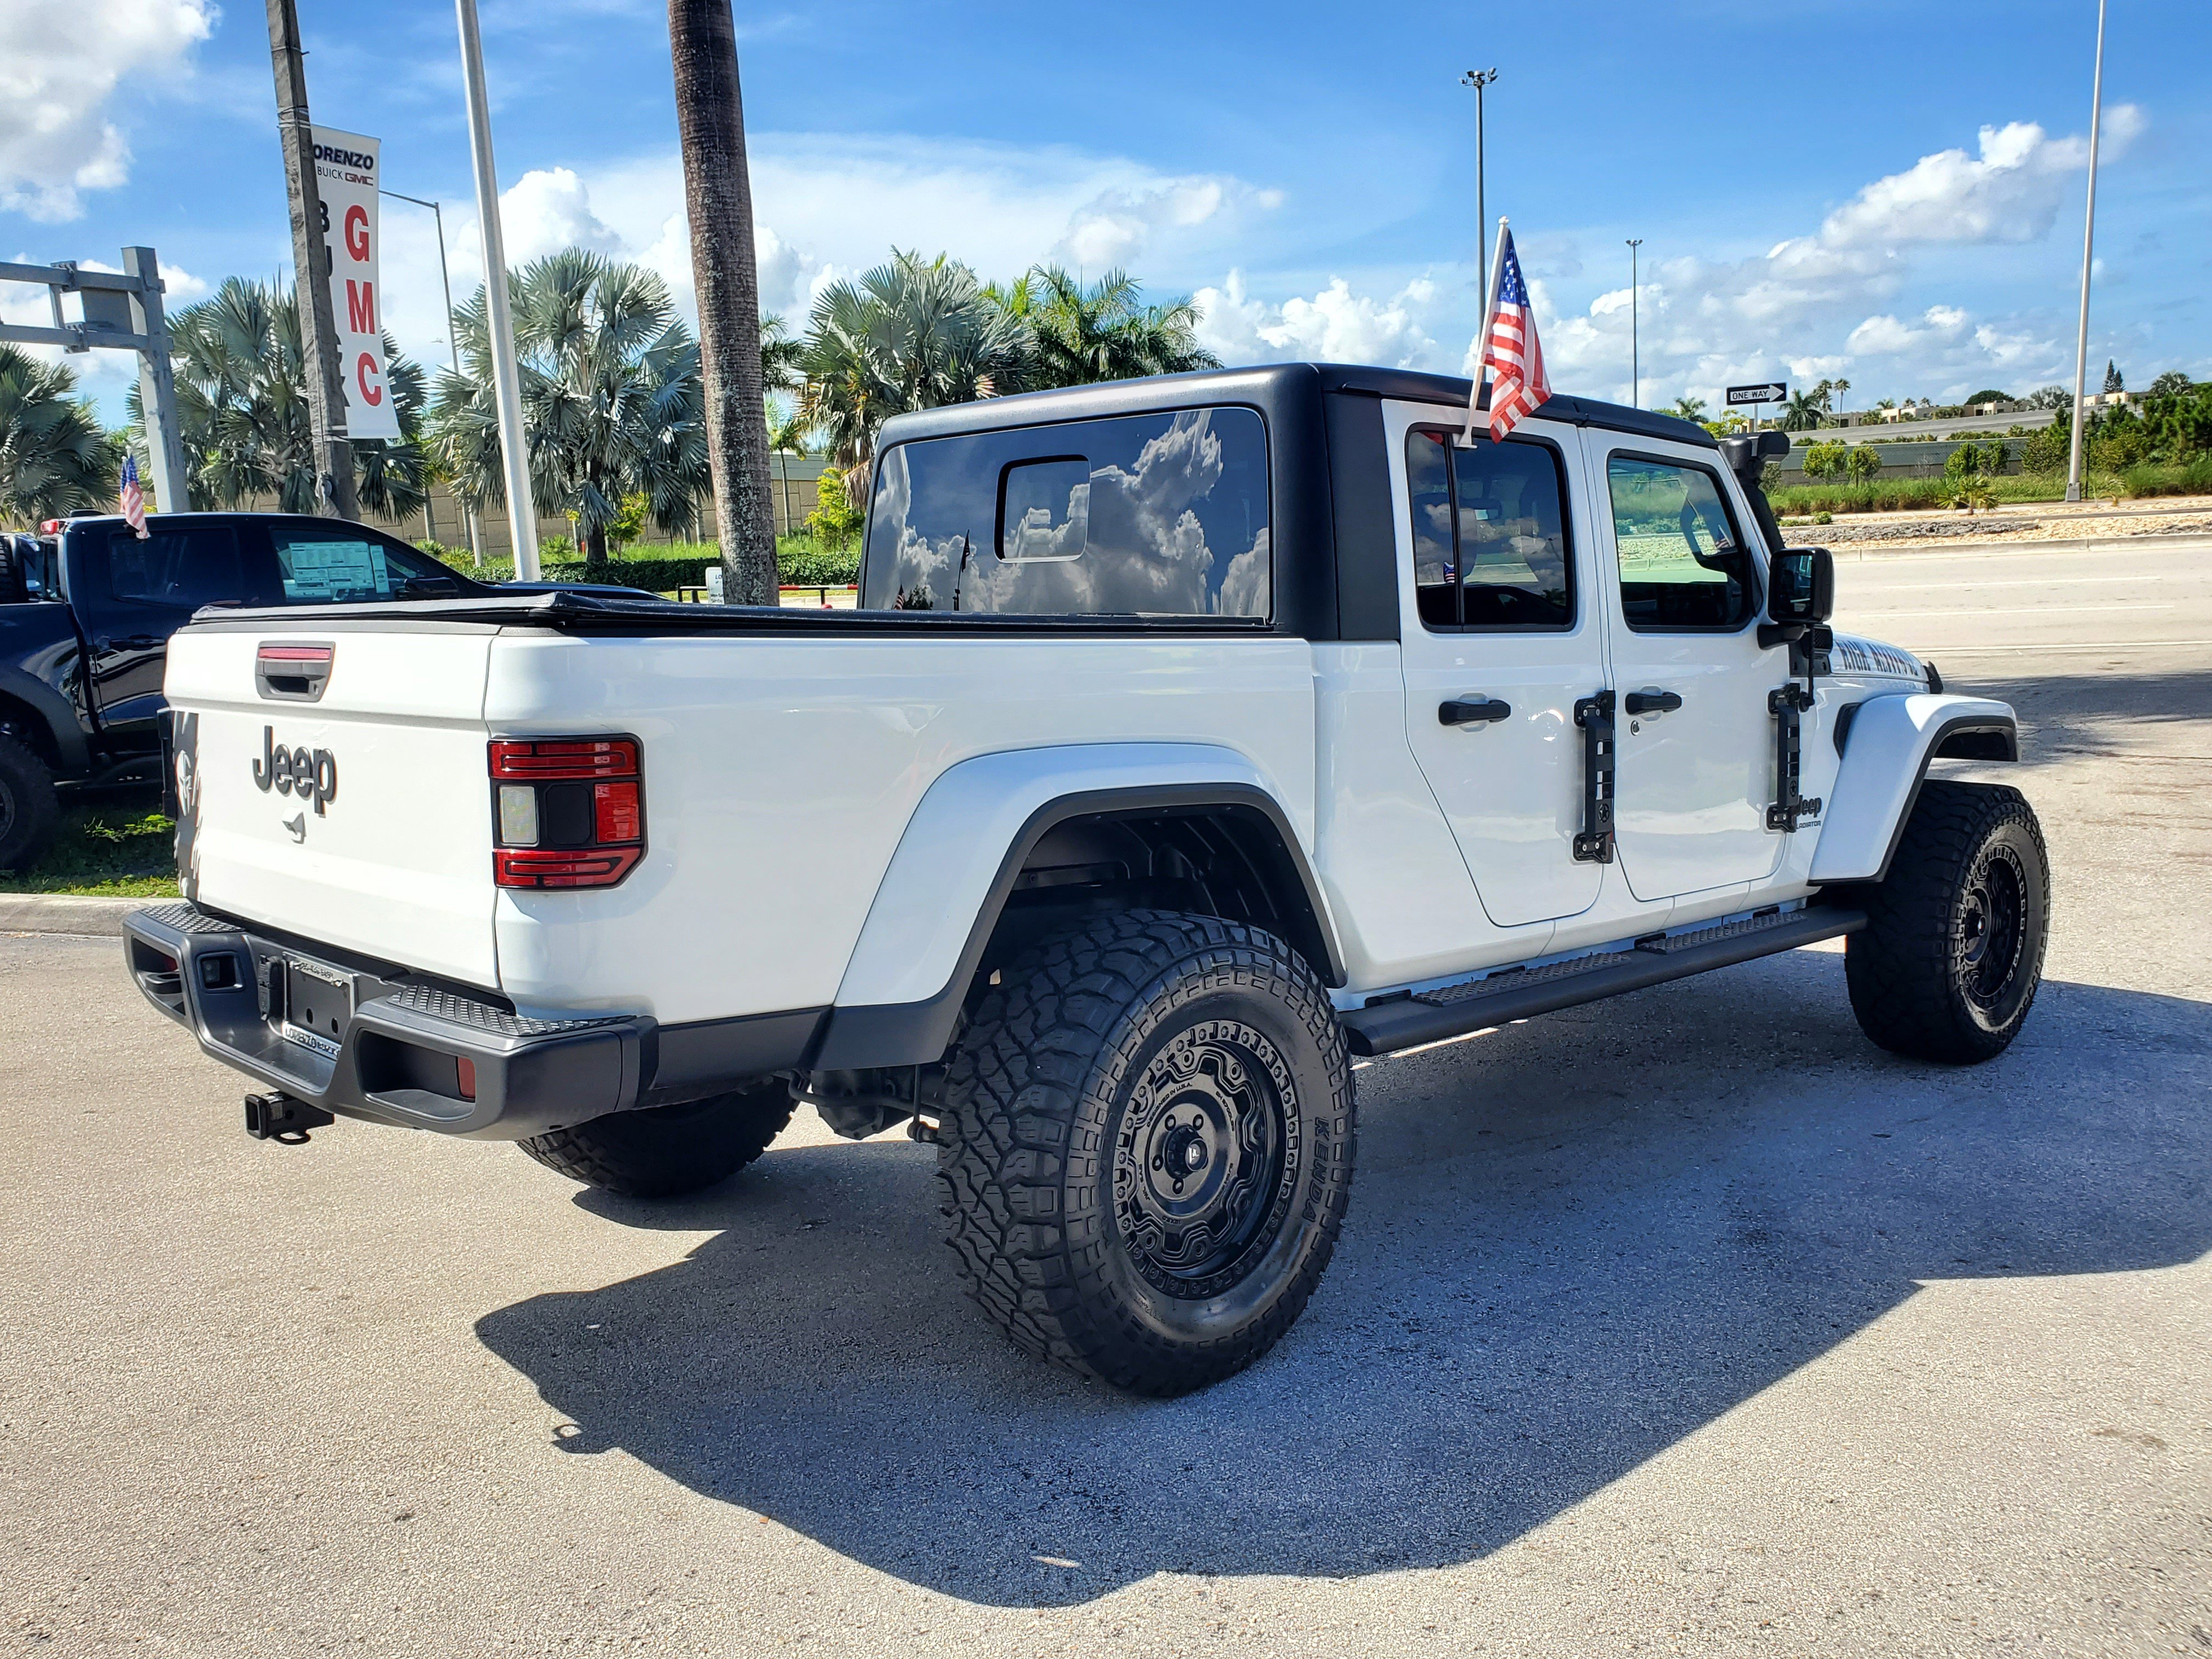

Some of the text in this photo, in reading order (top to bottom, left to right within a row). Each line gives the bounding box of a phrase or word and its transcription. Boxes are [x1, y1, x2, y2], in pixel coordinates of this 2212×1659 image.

[313, 144, 374, 170] ORENZO
[317, 166, 374, 186] BUICK GMC
[1732, 390, 1769, 399] ONE WAY
[252, 725, 337, 816] Jeep
[1796, 820, 1821, 830] LADIATOR
[1302, 1116, 1330, 1222] KENDA
